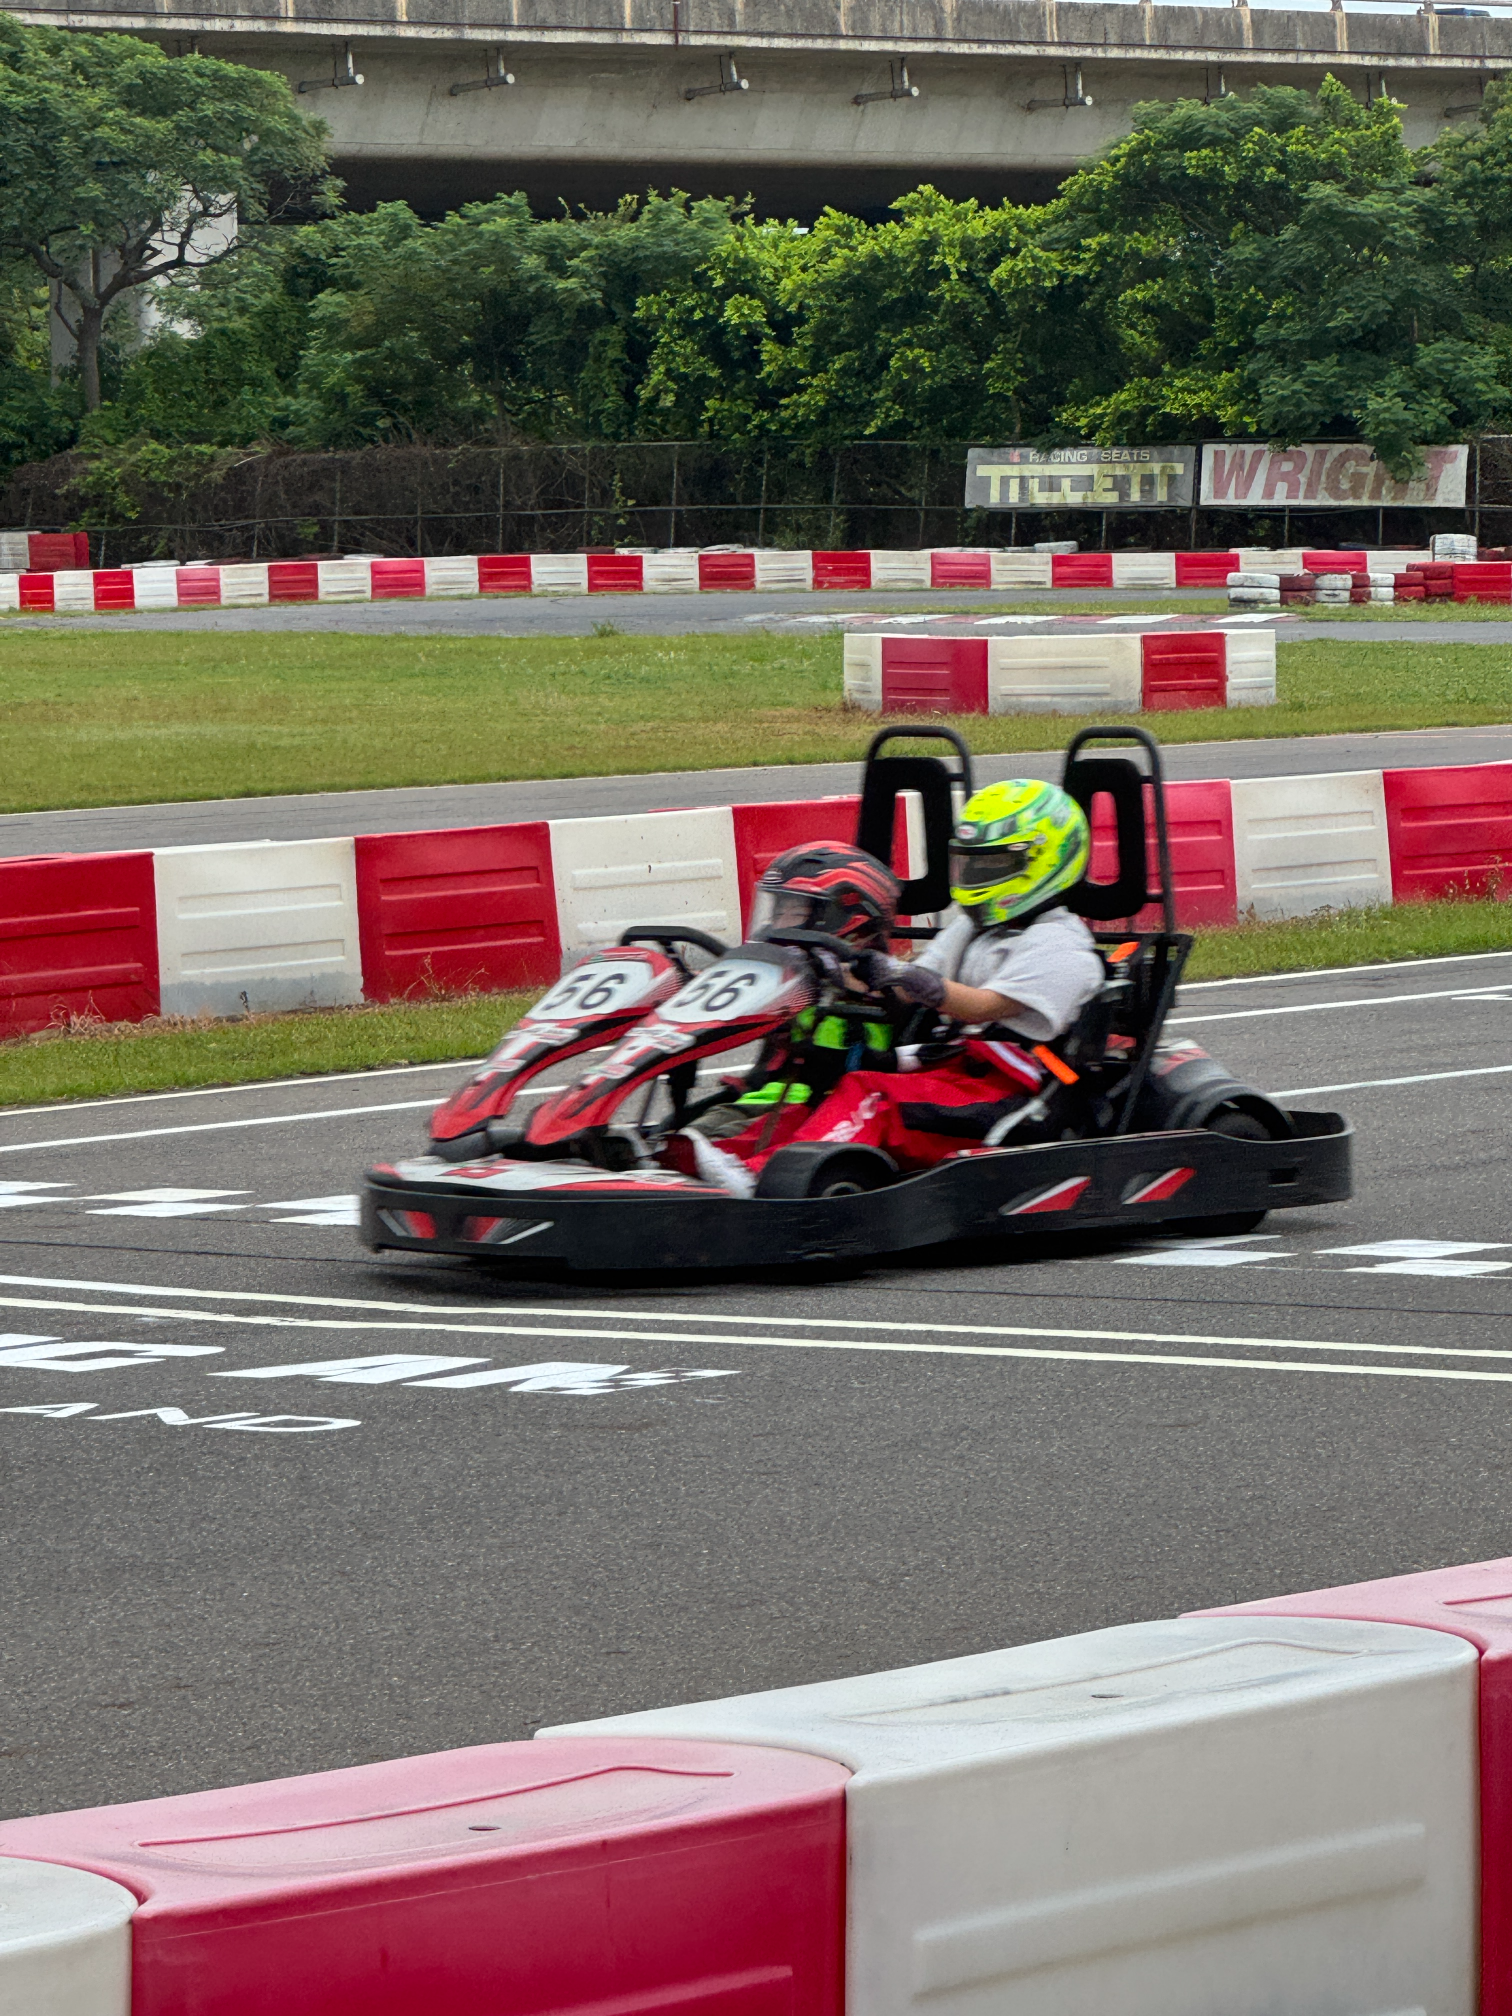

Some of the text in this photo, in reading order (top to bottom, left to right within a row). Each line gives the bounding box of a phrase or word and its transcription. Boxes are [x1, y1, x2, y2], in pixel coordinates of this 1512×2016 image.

[1101, 448, 1150, 461] SEATS
[976, 463, 1184, 503] TILLETT
[541, 972, 625, 1010] 56
[672, 969, 756, 1012] 56
